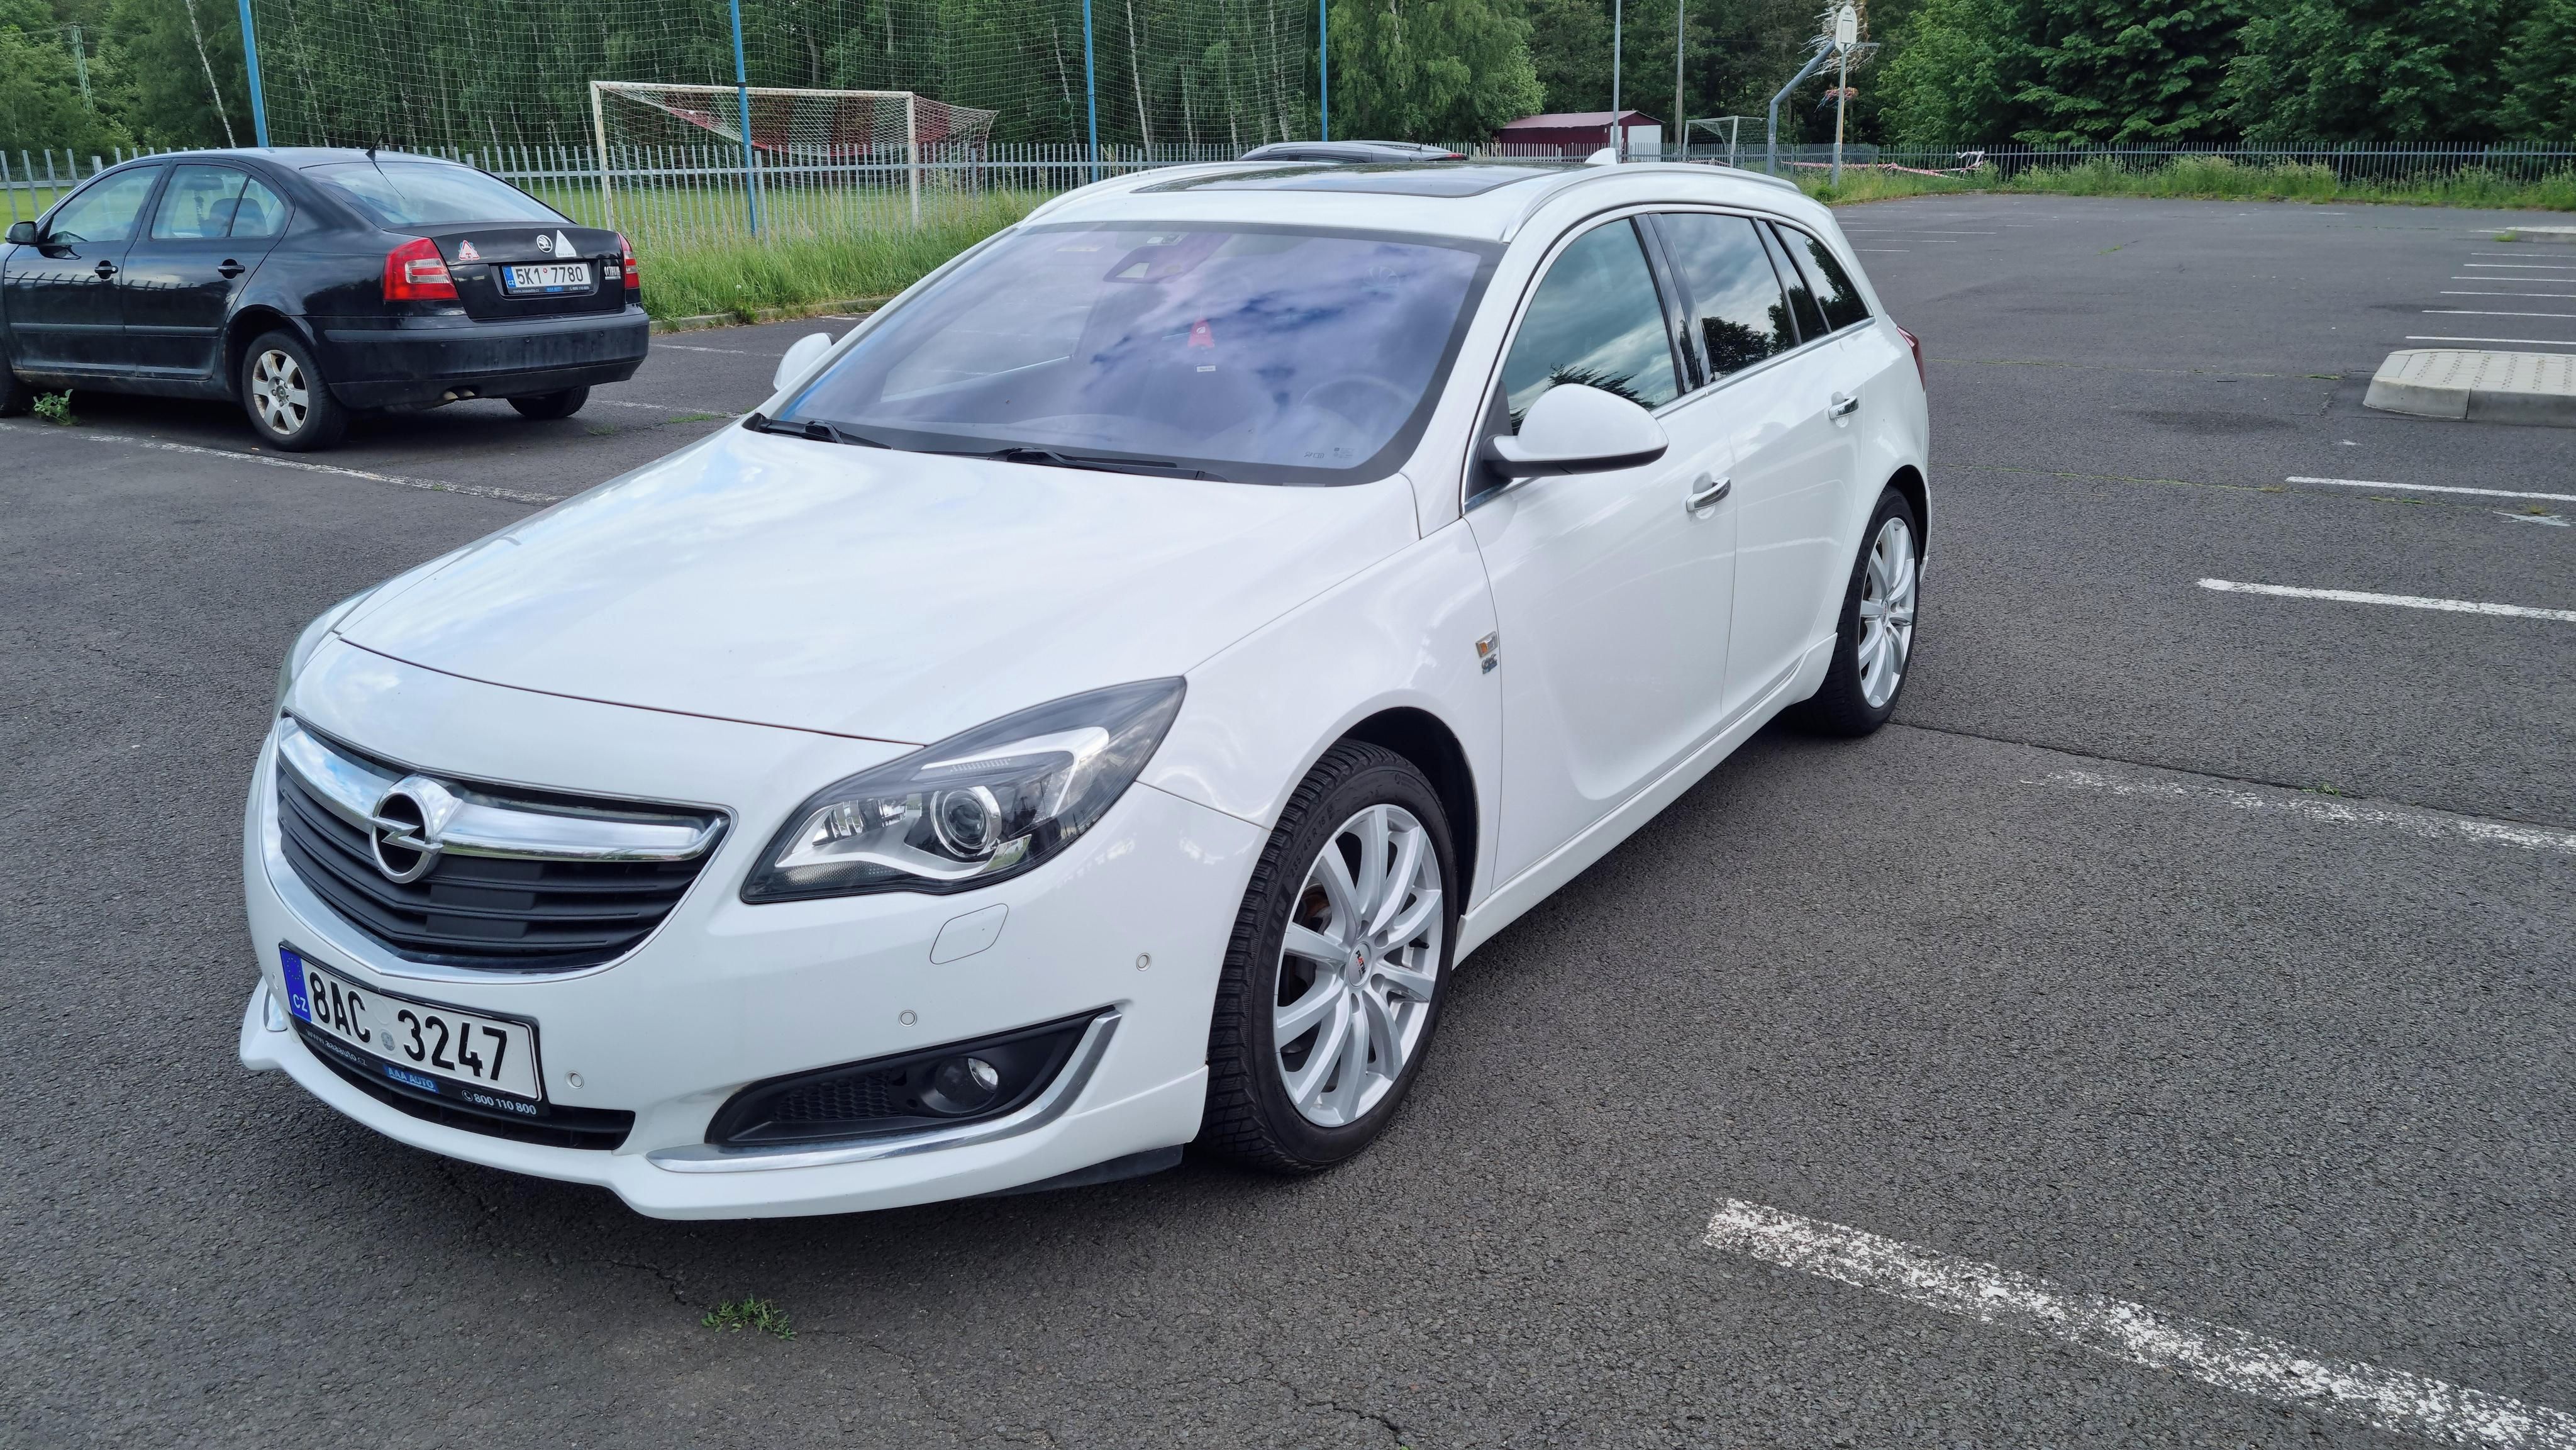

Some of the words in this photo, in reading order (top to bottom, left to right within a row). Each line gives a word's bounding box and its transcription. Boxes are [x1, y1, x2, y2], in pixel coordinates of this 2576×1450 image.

[516, 268, 541, 285] 5K1
[551, 266, 584, 283] 7780
[292, 993, 308, 1012] CZ
[309, 972, 370, 1043] 8AC
[397, 1009, 508, 1081] 3247
[306, 1030, 367, 1066] www.aaaauto.cz
[388, 1068, 408, 1081] AAA
[409, 1076, 434, 1088] AUTO
[474, 1093, 494, 1106] 800
[496, 1098, 514, 1110] 110
[515, 1103, 536, 1115] 800
